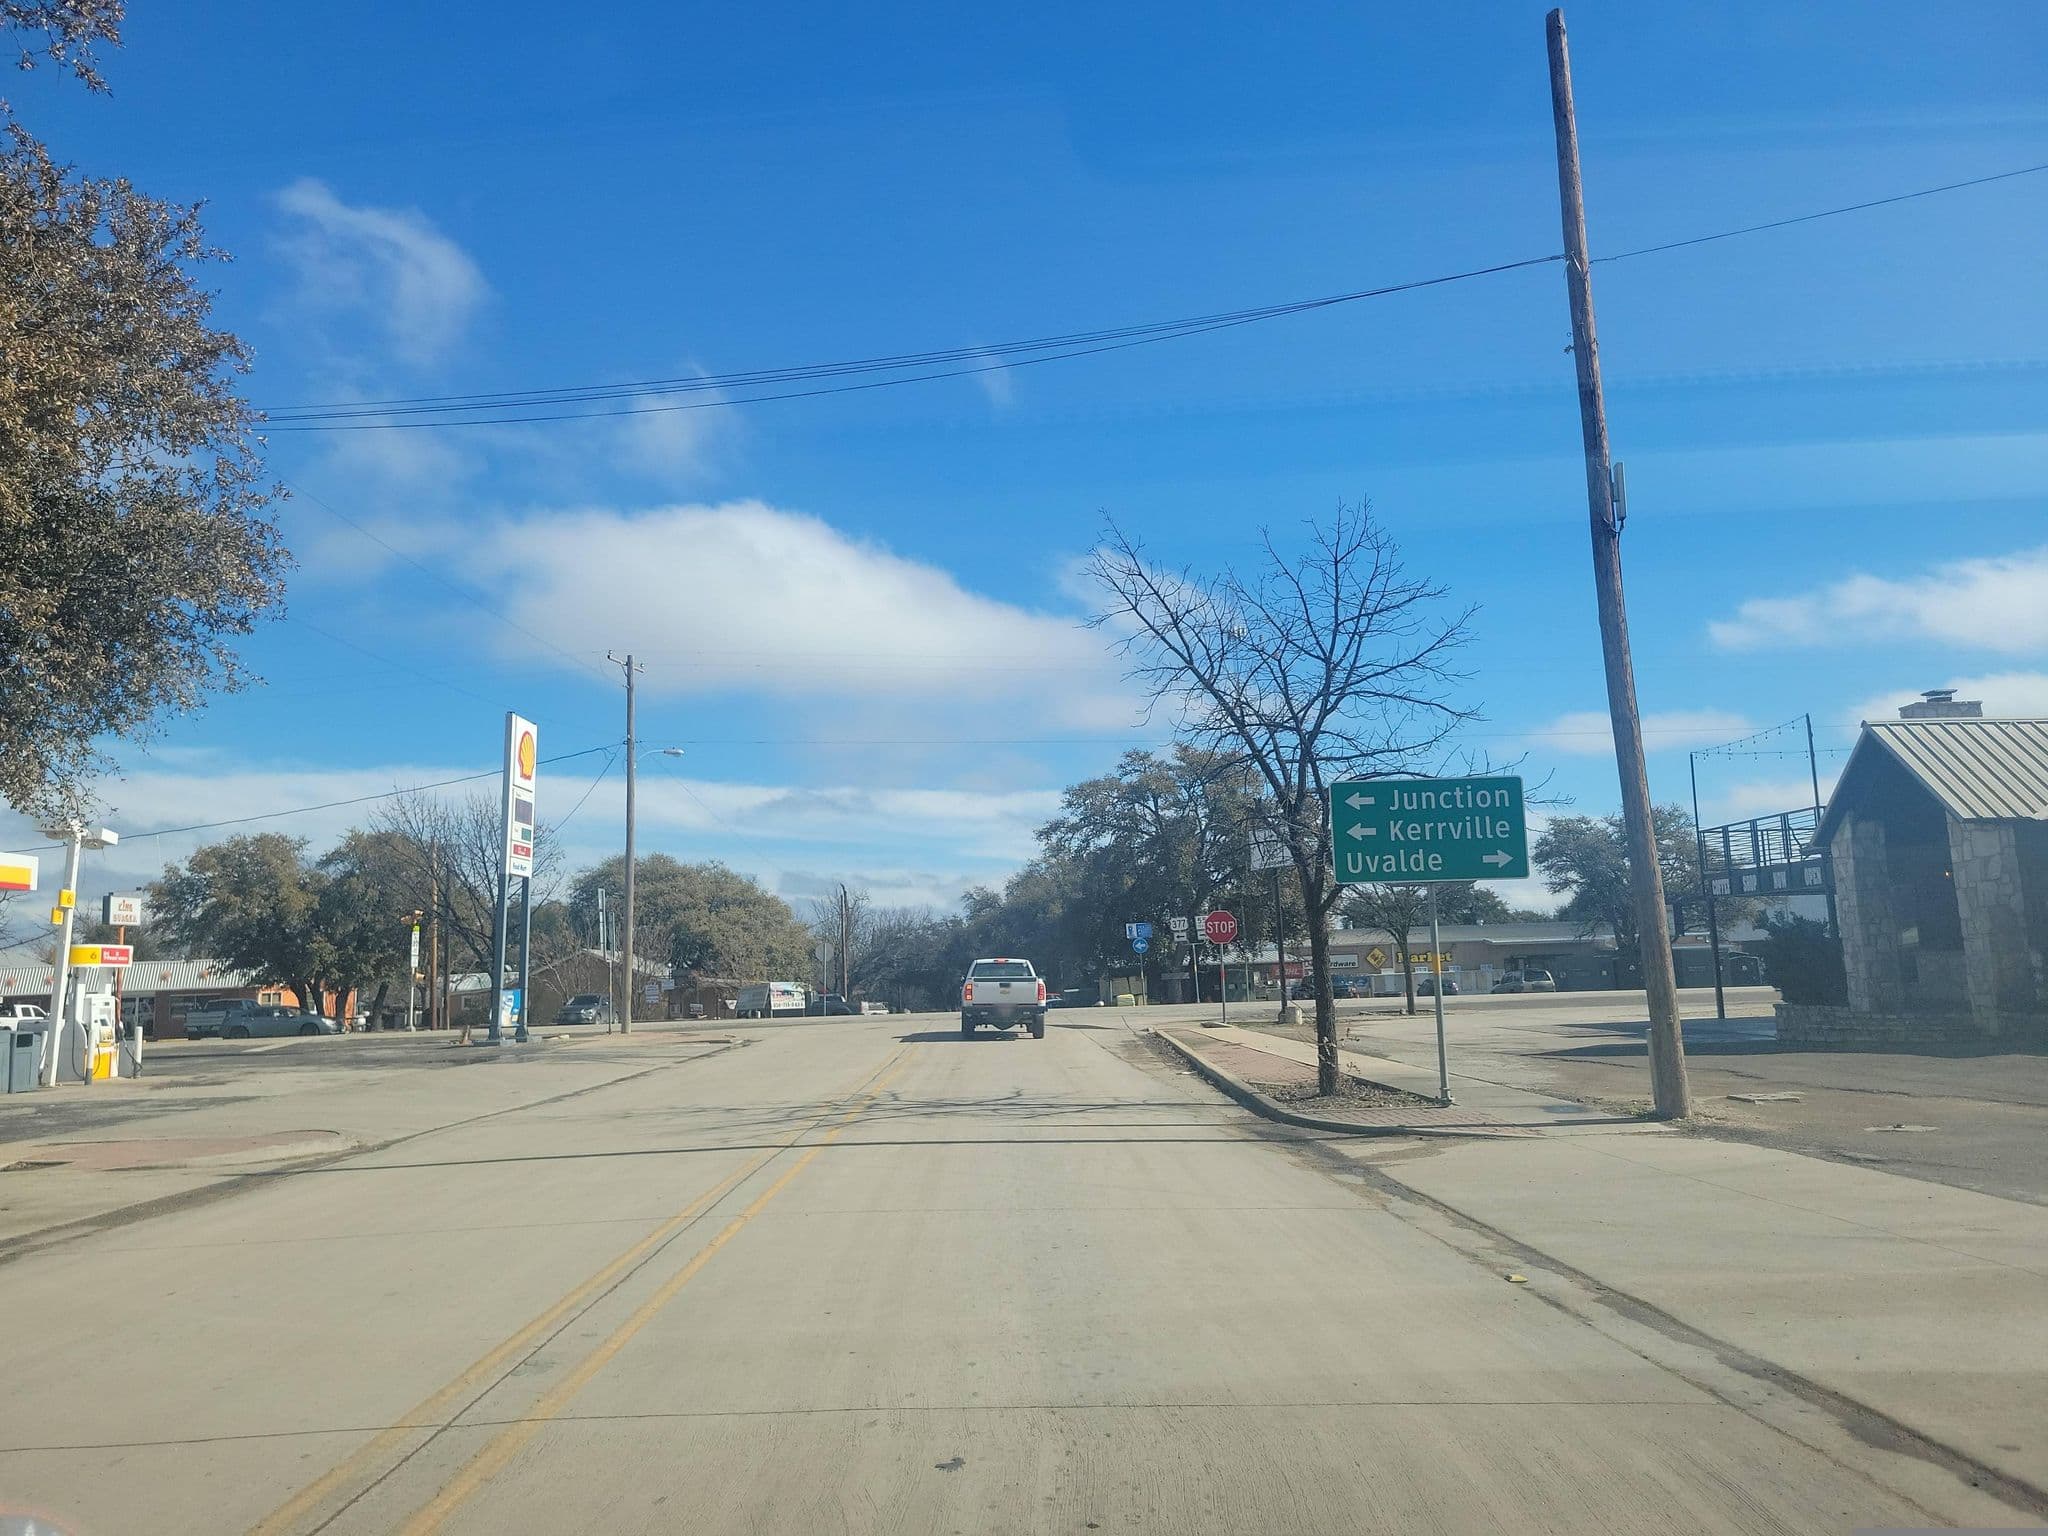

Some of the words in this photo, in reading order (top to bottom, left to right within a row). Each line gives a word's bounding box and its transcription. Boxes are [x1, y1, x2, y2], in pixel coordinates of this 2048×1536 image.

[1389, 785, 1511, 811] Junction
[1389, 815, 1511, 841] Kerrville
[1346, 849, 1443, 874] Uvalde
[67, 894, 72, 904] 6
[1171, 919, 1186, 929] 377
[1206, 921, 1235, 934] STOP
[90, 951, 97, 960] 6
